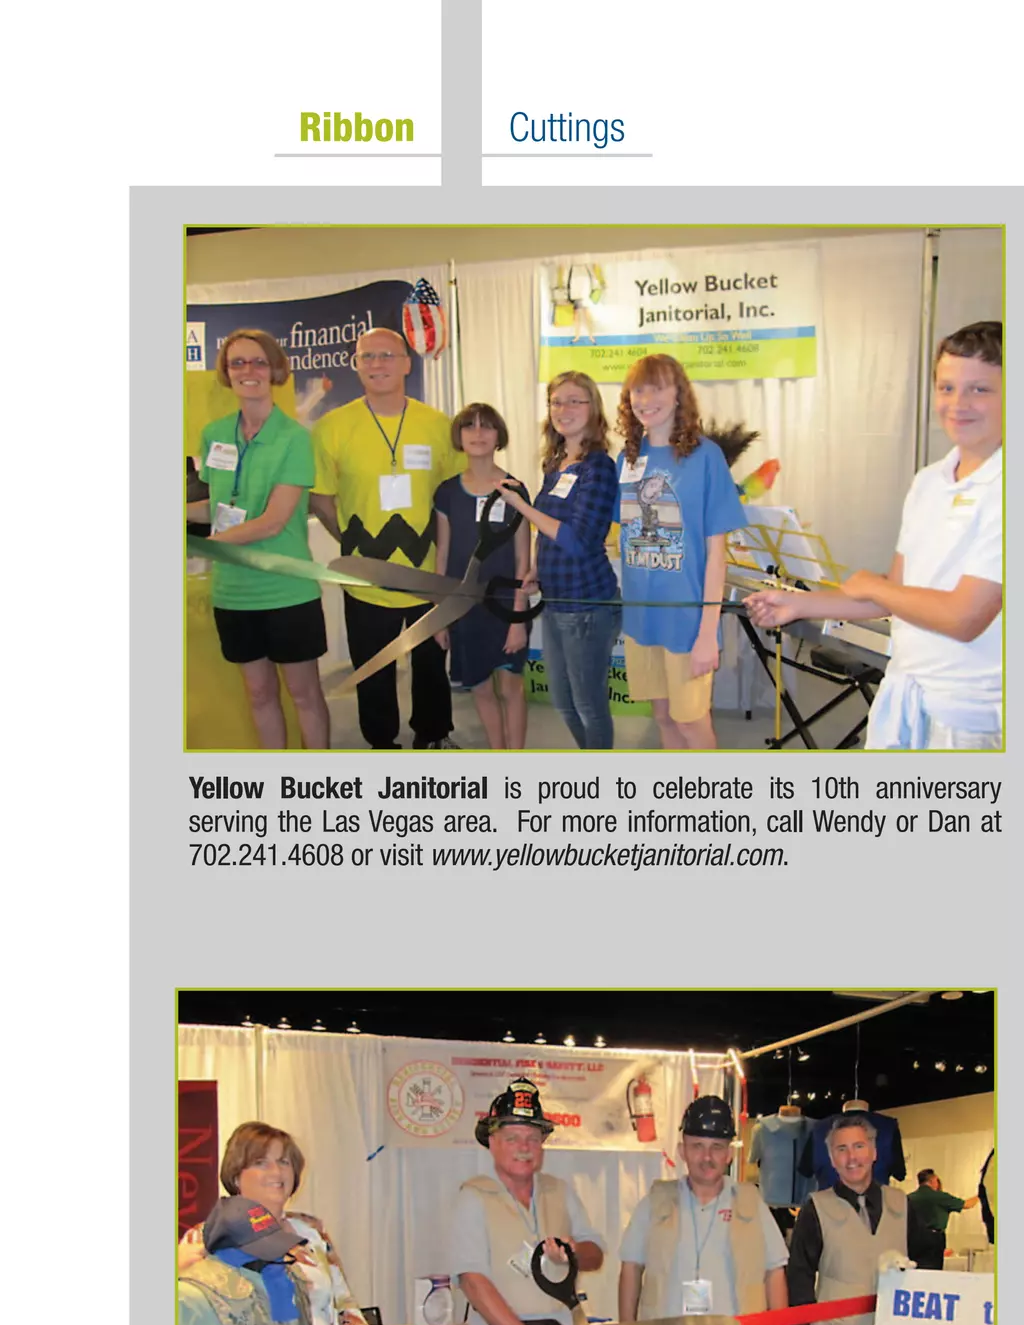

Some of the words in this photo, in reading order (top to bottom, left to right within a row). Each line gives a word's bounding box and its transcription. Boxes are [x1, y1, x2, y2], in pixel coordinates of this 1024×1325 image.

[300, 112, 414, 143] Ribbon
[510, 112, 625, 149] Cuttings
[635, 278, 698, 297] Yellow
[704, 272, 779, 293] Bucket
[638, 303, 731, 328] Janitorial,
[738, 301, 776, 319] Inc.
[290, 310, 373, 349] financial
[650, 552, 684, 571] DUST
[189, 844, 343, 866] 702.241.4608
[352, 848, 373, 866] or
[380, 843, 423, 866] visit
[433, 843, 788, 871] www.yellowbucketjanitorial.com.
[892, 1289, 961, 1322] BEAT
